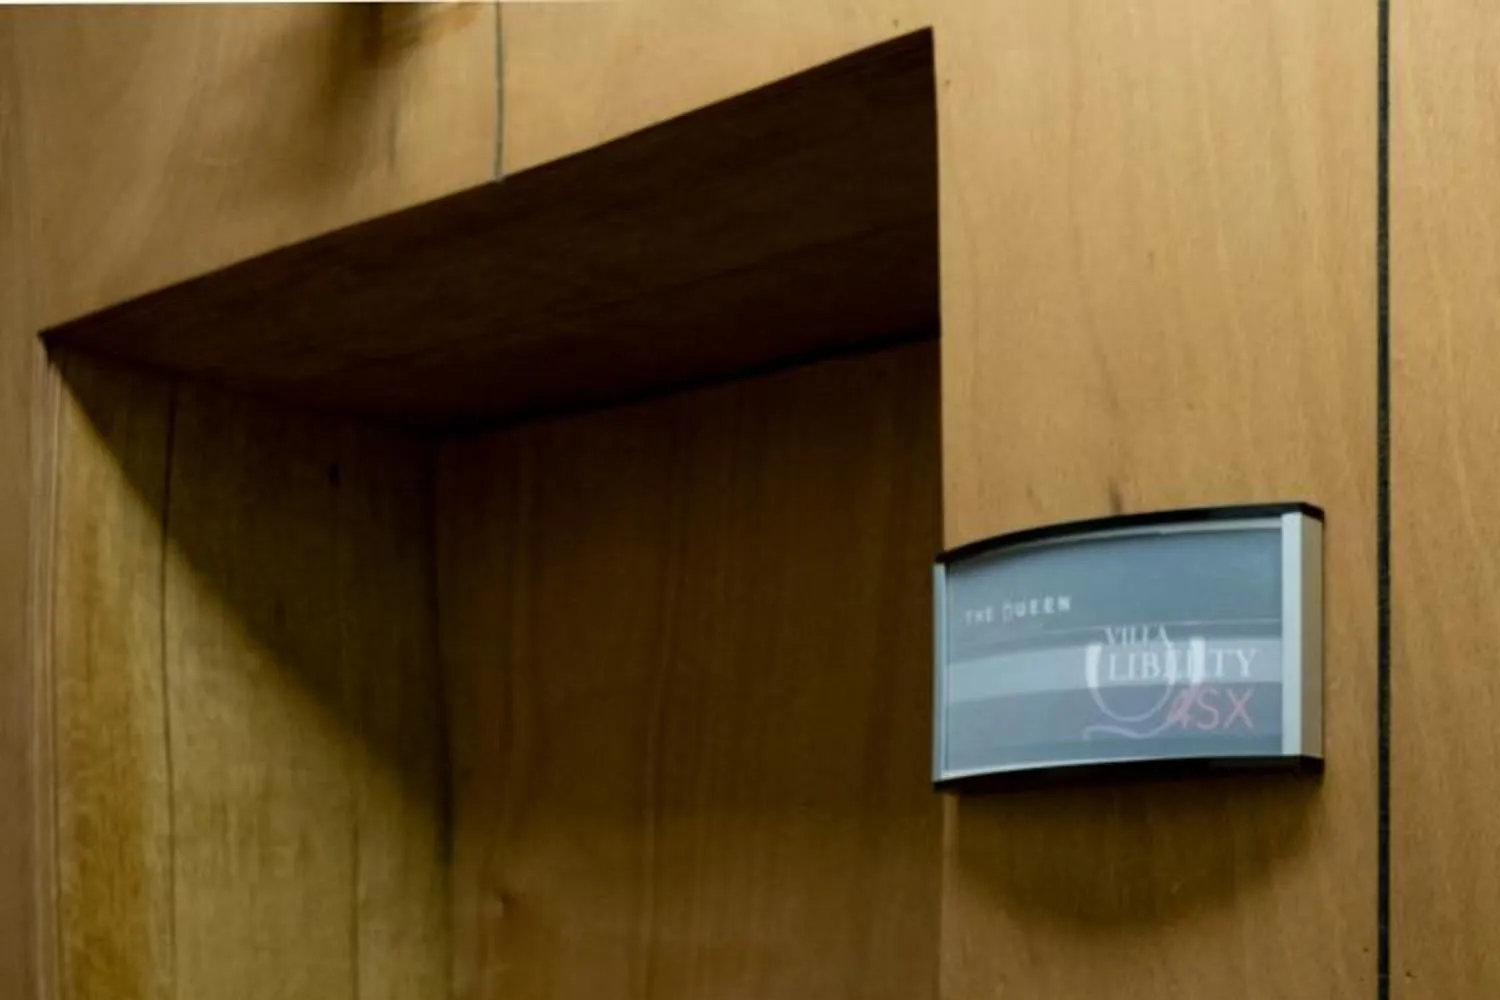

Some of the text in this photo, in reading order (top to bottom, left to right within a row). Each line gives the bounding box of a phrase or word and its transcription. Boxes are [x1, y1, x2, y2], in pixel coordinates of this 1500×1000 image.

[964, 596, 1070, 627] THE QUEEN
[1103, 624, 1171, 647] VILLA
[1108, 647, 1258, 681] LIBETY
